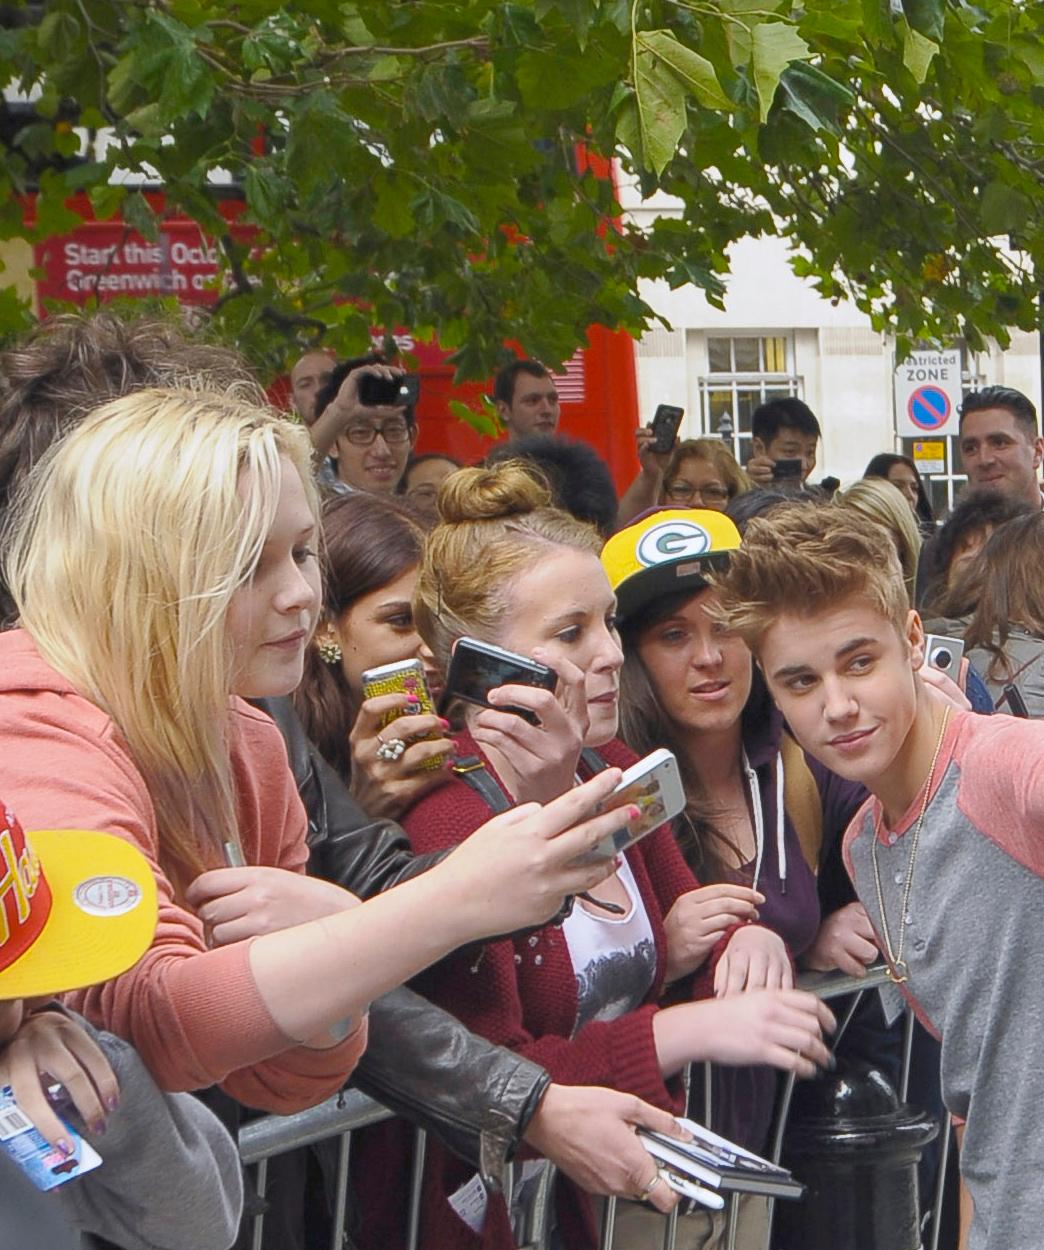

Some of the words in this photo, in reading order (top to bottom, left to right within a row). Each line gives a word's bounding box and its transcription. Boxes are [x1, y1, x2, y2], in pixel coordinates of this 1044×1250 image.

[64, 243, 120, 266] Start
[124, 242, 162, 265] this
[66, 269, 188, 292] Greenwich
[904, 354, 956, 366] estricted
[906, 368, 949, 381] ZONE
